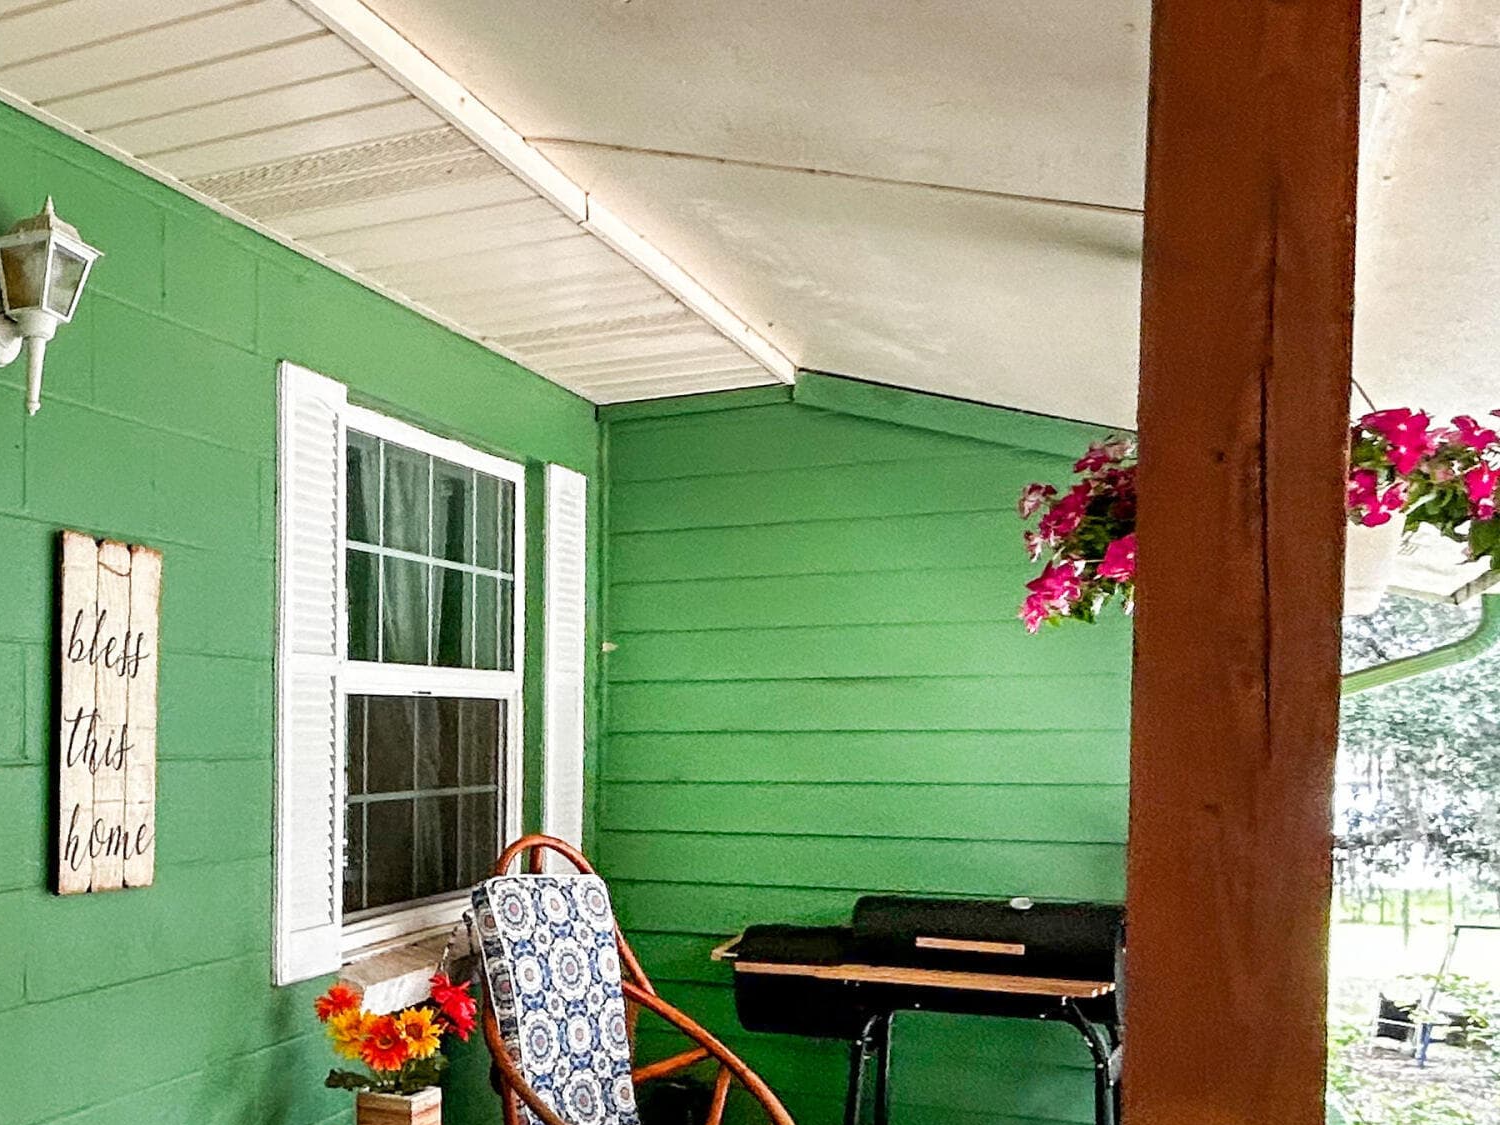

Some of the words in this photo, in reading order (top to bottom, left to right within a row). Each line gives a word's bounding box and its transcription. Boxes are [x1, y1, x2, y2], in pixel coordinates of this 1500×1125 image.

[67, 609, 149, 679] bless
[64, 706, 135, 775] this
[64, 803, 155, 872] home
